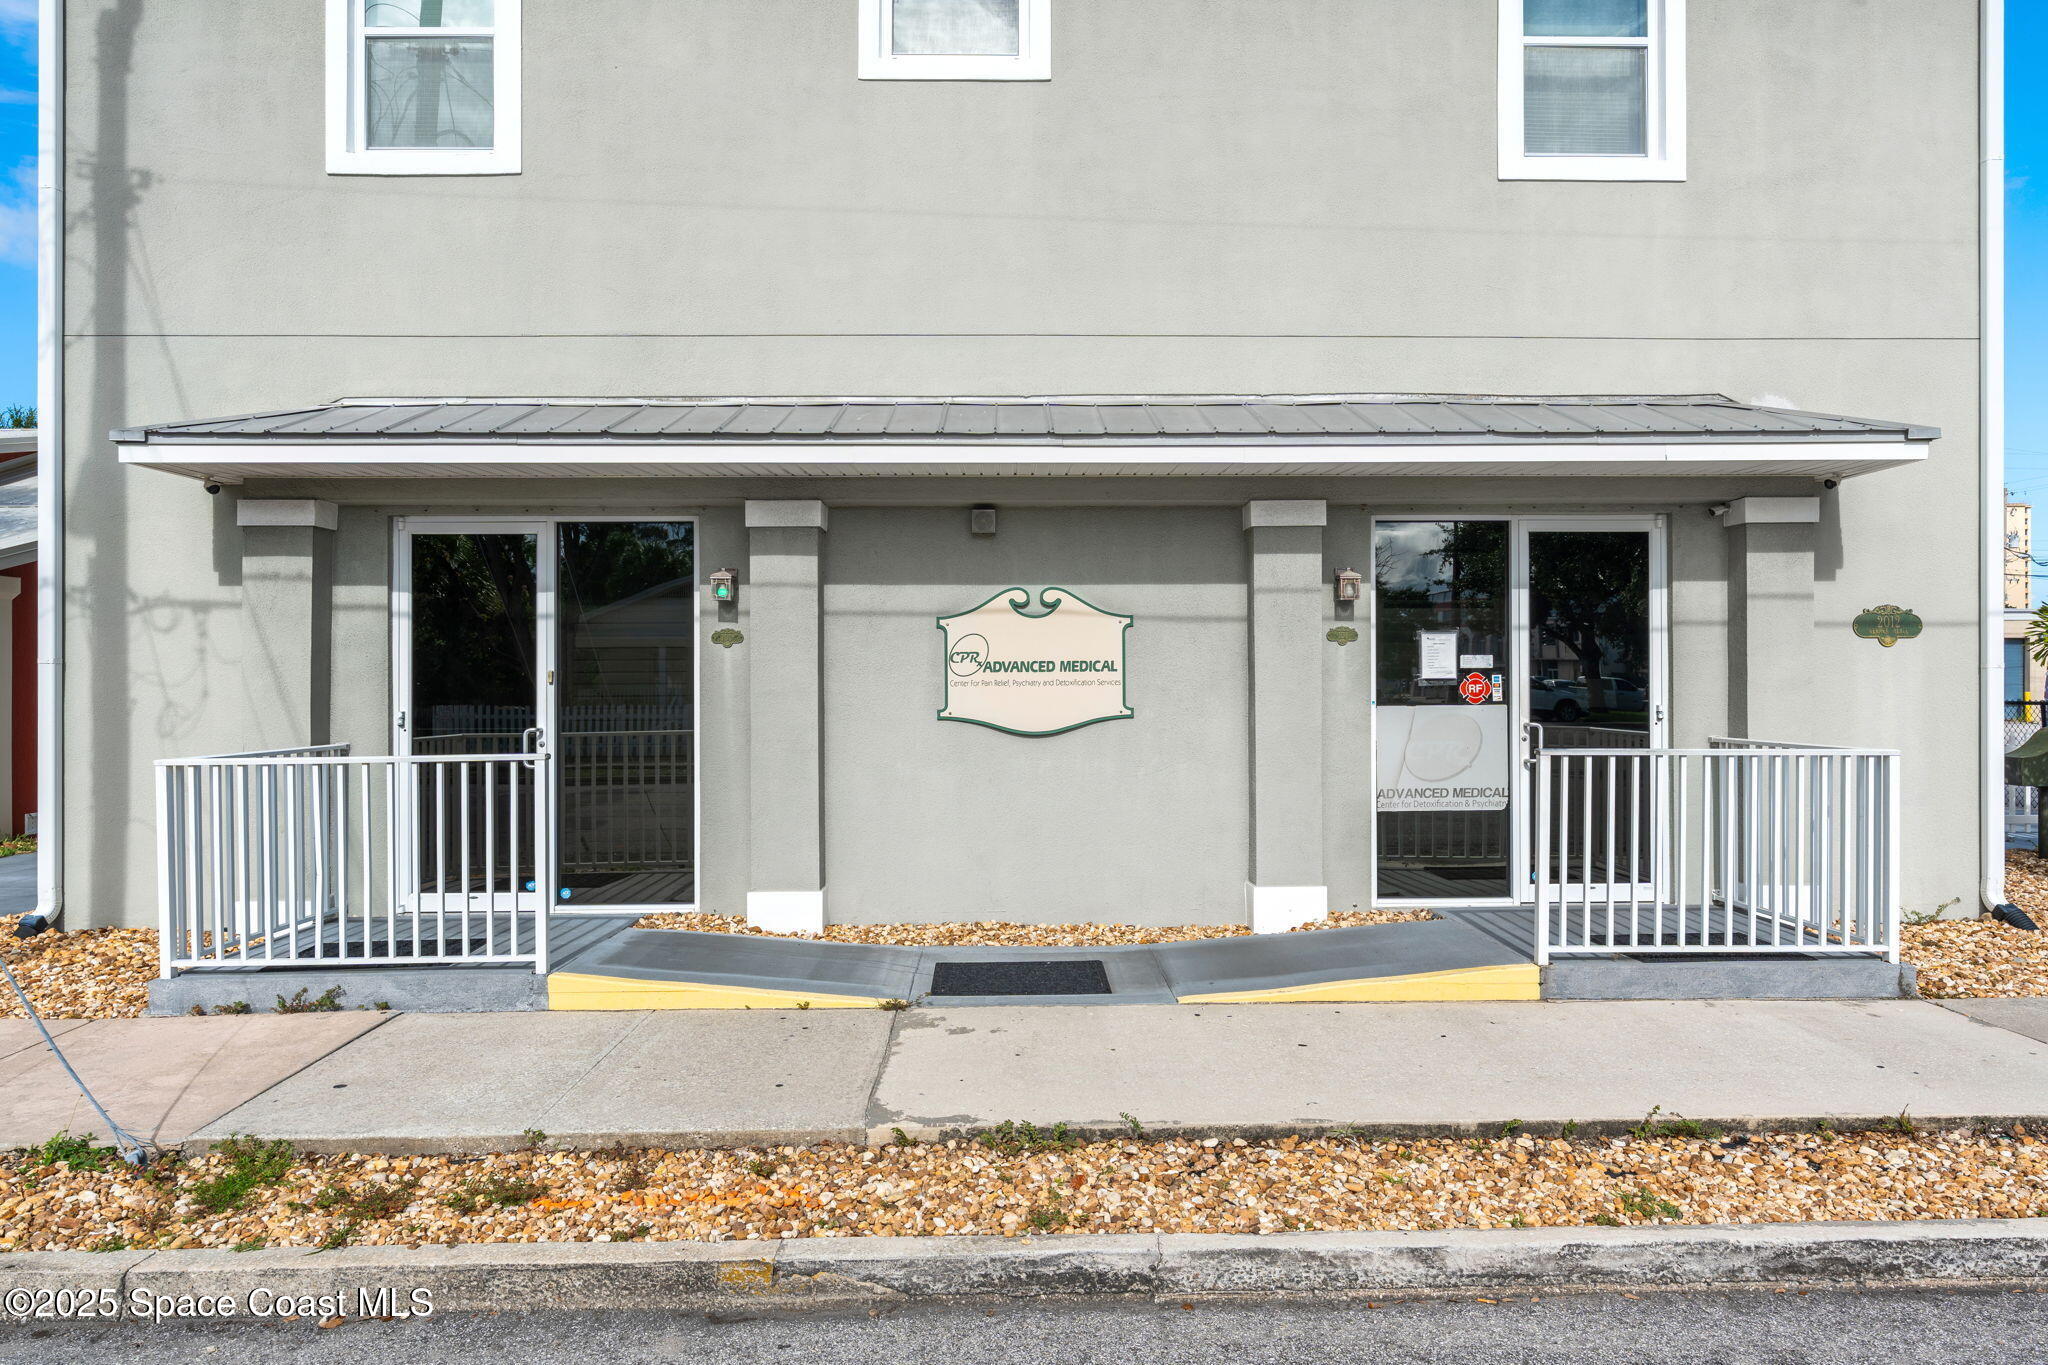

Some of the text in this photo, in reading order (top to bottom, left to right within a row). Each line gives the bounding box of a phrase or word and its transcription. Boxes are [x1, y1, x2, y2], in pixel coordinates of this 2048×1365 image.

[1876, 615, 1901, 628] 2012
[950, 651, 982, 667] CPR
[983, 660, 1118, 673] ADVANCED MEDICAL
[1012, 679, 1041, 688] Psychiatry
[1055, 679, 1096, 687] Detoxification
[1468, 684, 1483, 693] RF
[1376, 787, 1509, 799] ADVANCED MEDICAL
[1377, 799, 1508, 809] Center for Detoxification & Psychiatry
